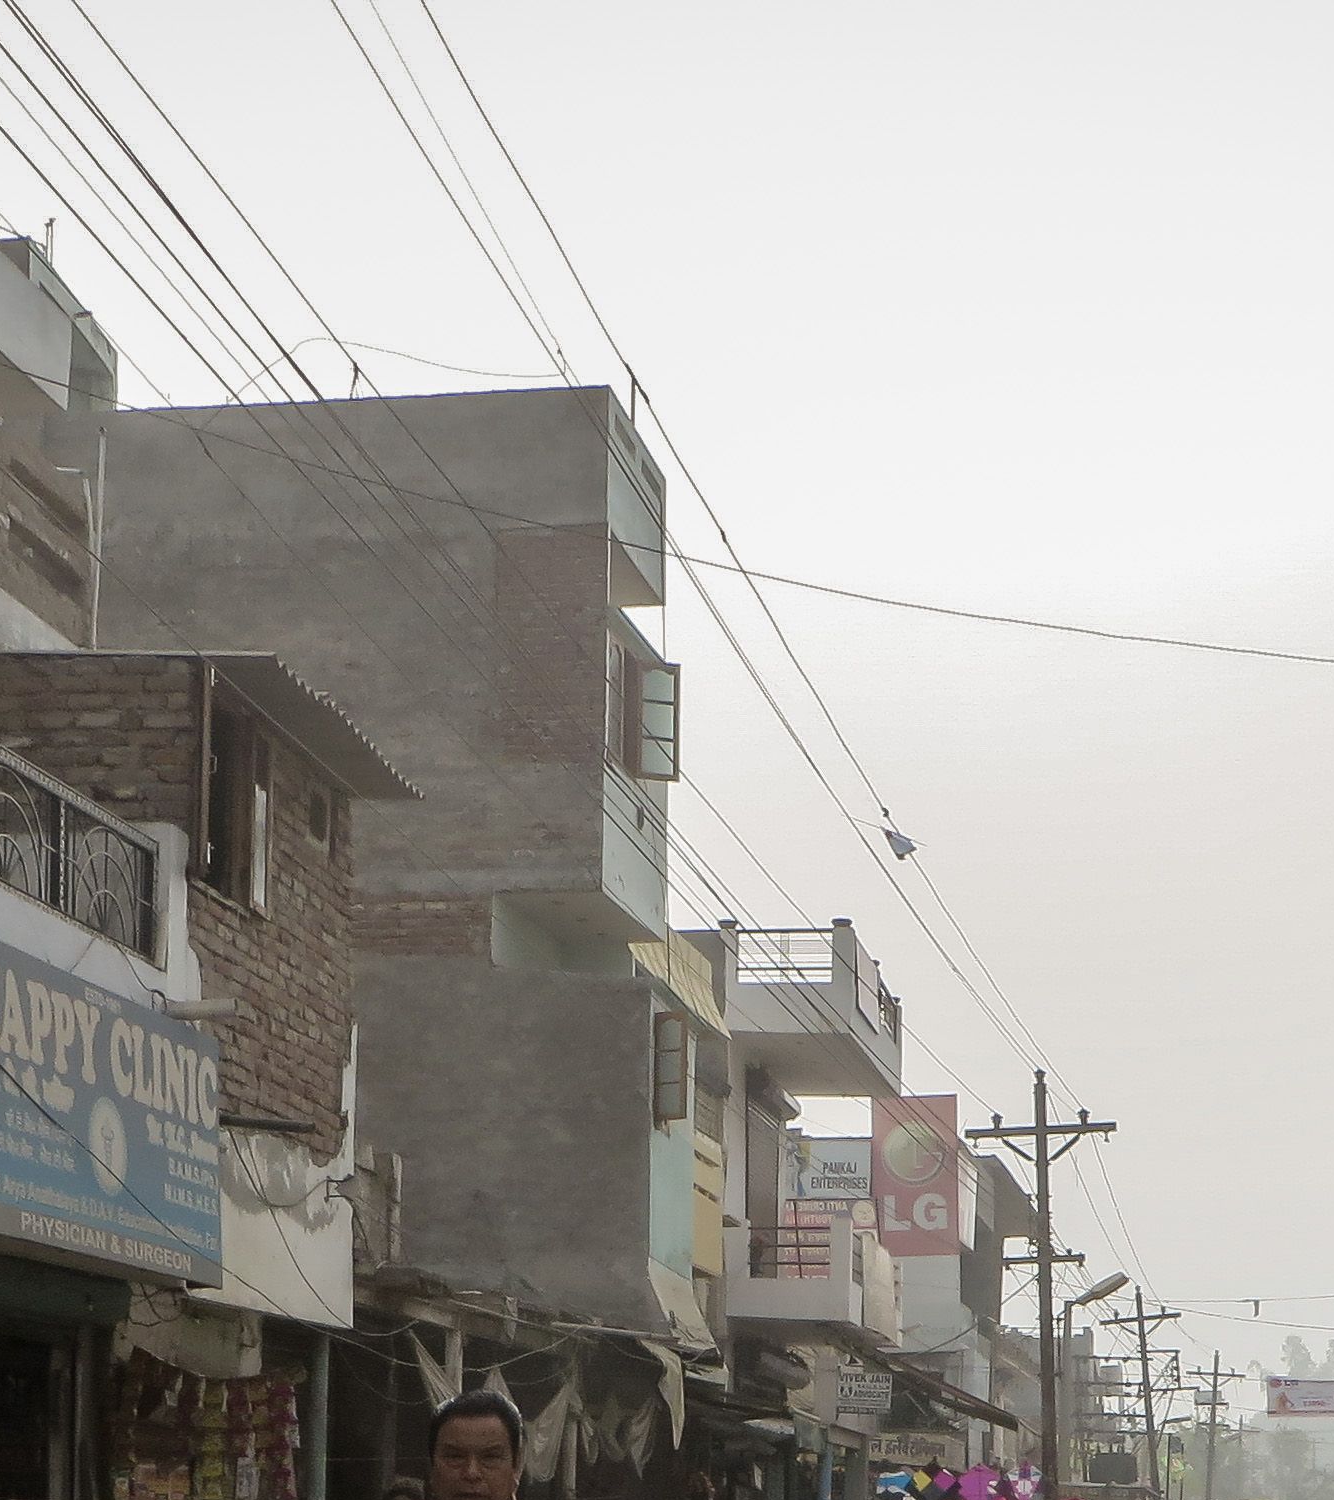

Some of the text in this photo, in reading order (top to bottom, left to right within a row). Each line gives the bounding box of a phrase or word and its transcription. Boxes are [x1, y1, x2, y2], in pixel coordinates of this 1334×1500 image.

[110, 1017, 217, 1130] CLINIC
[20, 1211, 107, 1250] PHYSICIAN
[110, 1235, 121, 1254] &
[125, 1238, 192, 1274] SURGEON
[884, 1193, 949, 1231] LG
